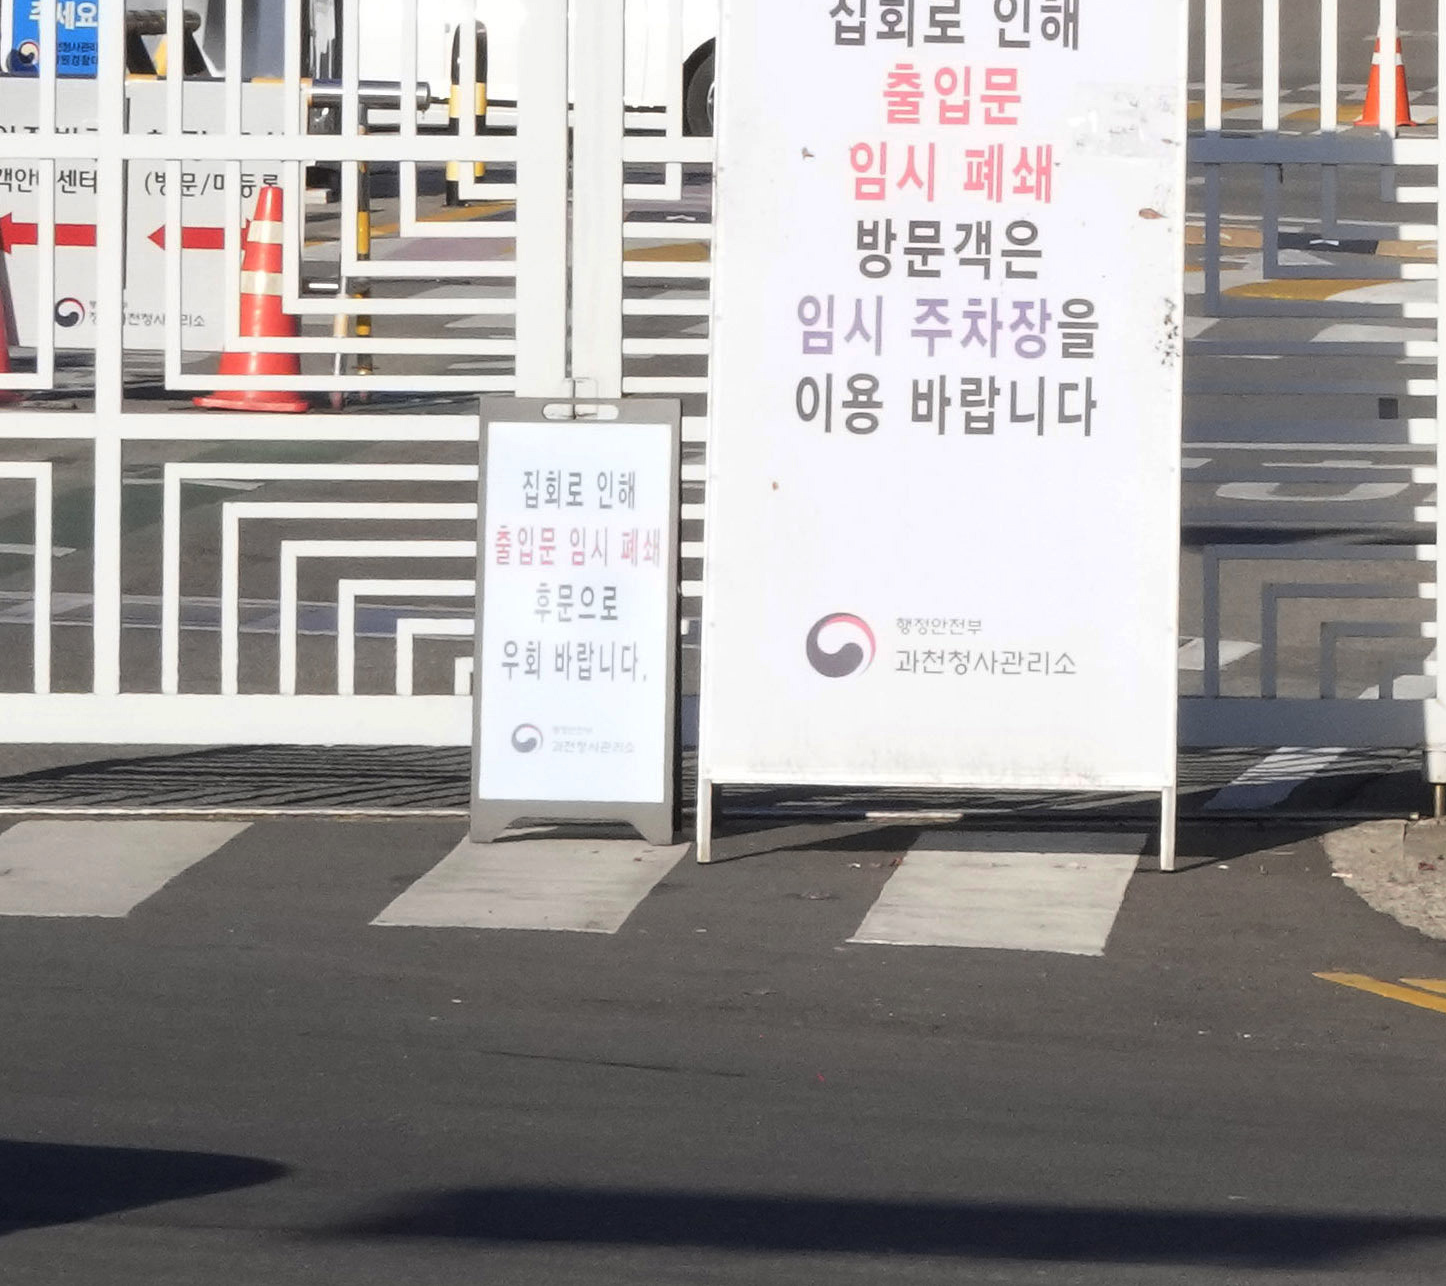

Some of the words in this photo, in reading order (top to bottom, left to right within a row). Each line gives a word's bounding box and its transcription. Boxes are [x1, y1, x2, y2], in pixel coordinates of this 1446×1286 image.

[882, 62, 1024, 128] 출입문
[849, 141, 938, 205] 임시
[963, 142, 1055, 206] 폐쇄
[856, 218, 1044, 282] 방문객은
[797, 294, 886, 358] 임시
[910, 297, 1102, 362] 주차장을
[795, 372, 886, 437] 이용
[911, 374, 1100, 439] 바랍니다
[522, 471, 584, 511] 집회로
[597, 471, 636, 511] 인해
[495, 526, 557, 567] 출입문
[569, 527, 609, 568] 임시
[621, 527, 661, 567] 폐쇄
[534, 583, 619, 624] 후문으로
[896, 617, 982, 637] 행정안전부
[501, 641, 542, 681] 우회
[895, 649, 1078, 677] 과천청사관리소
